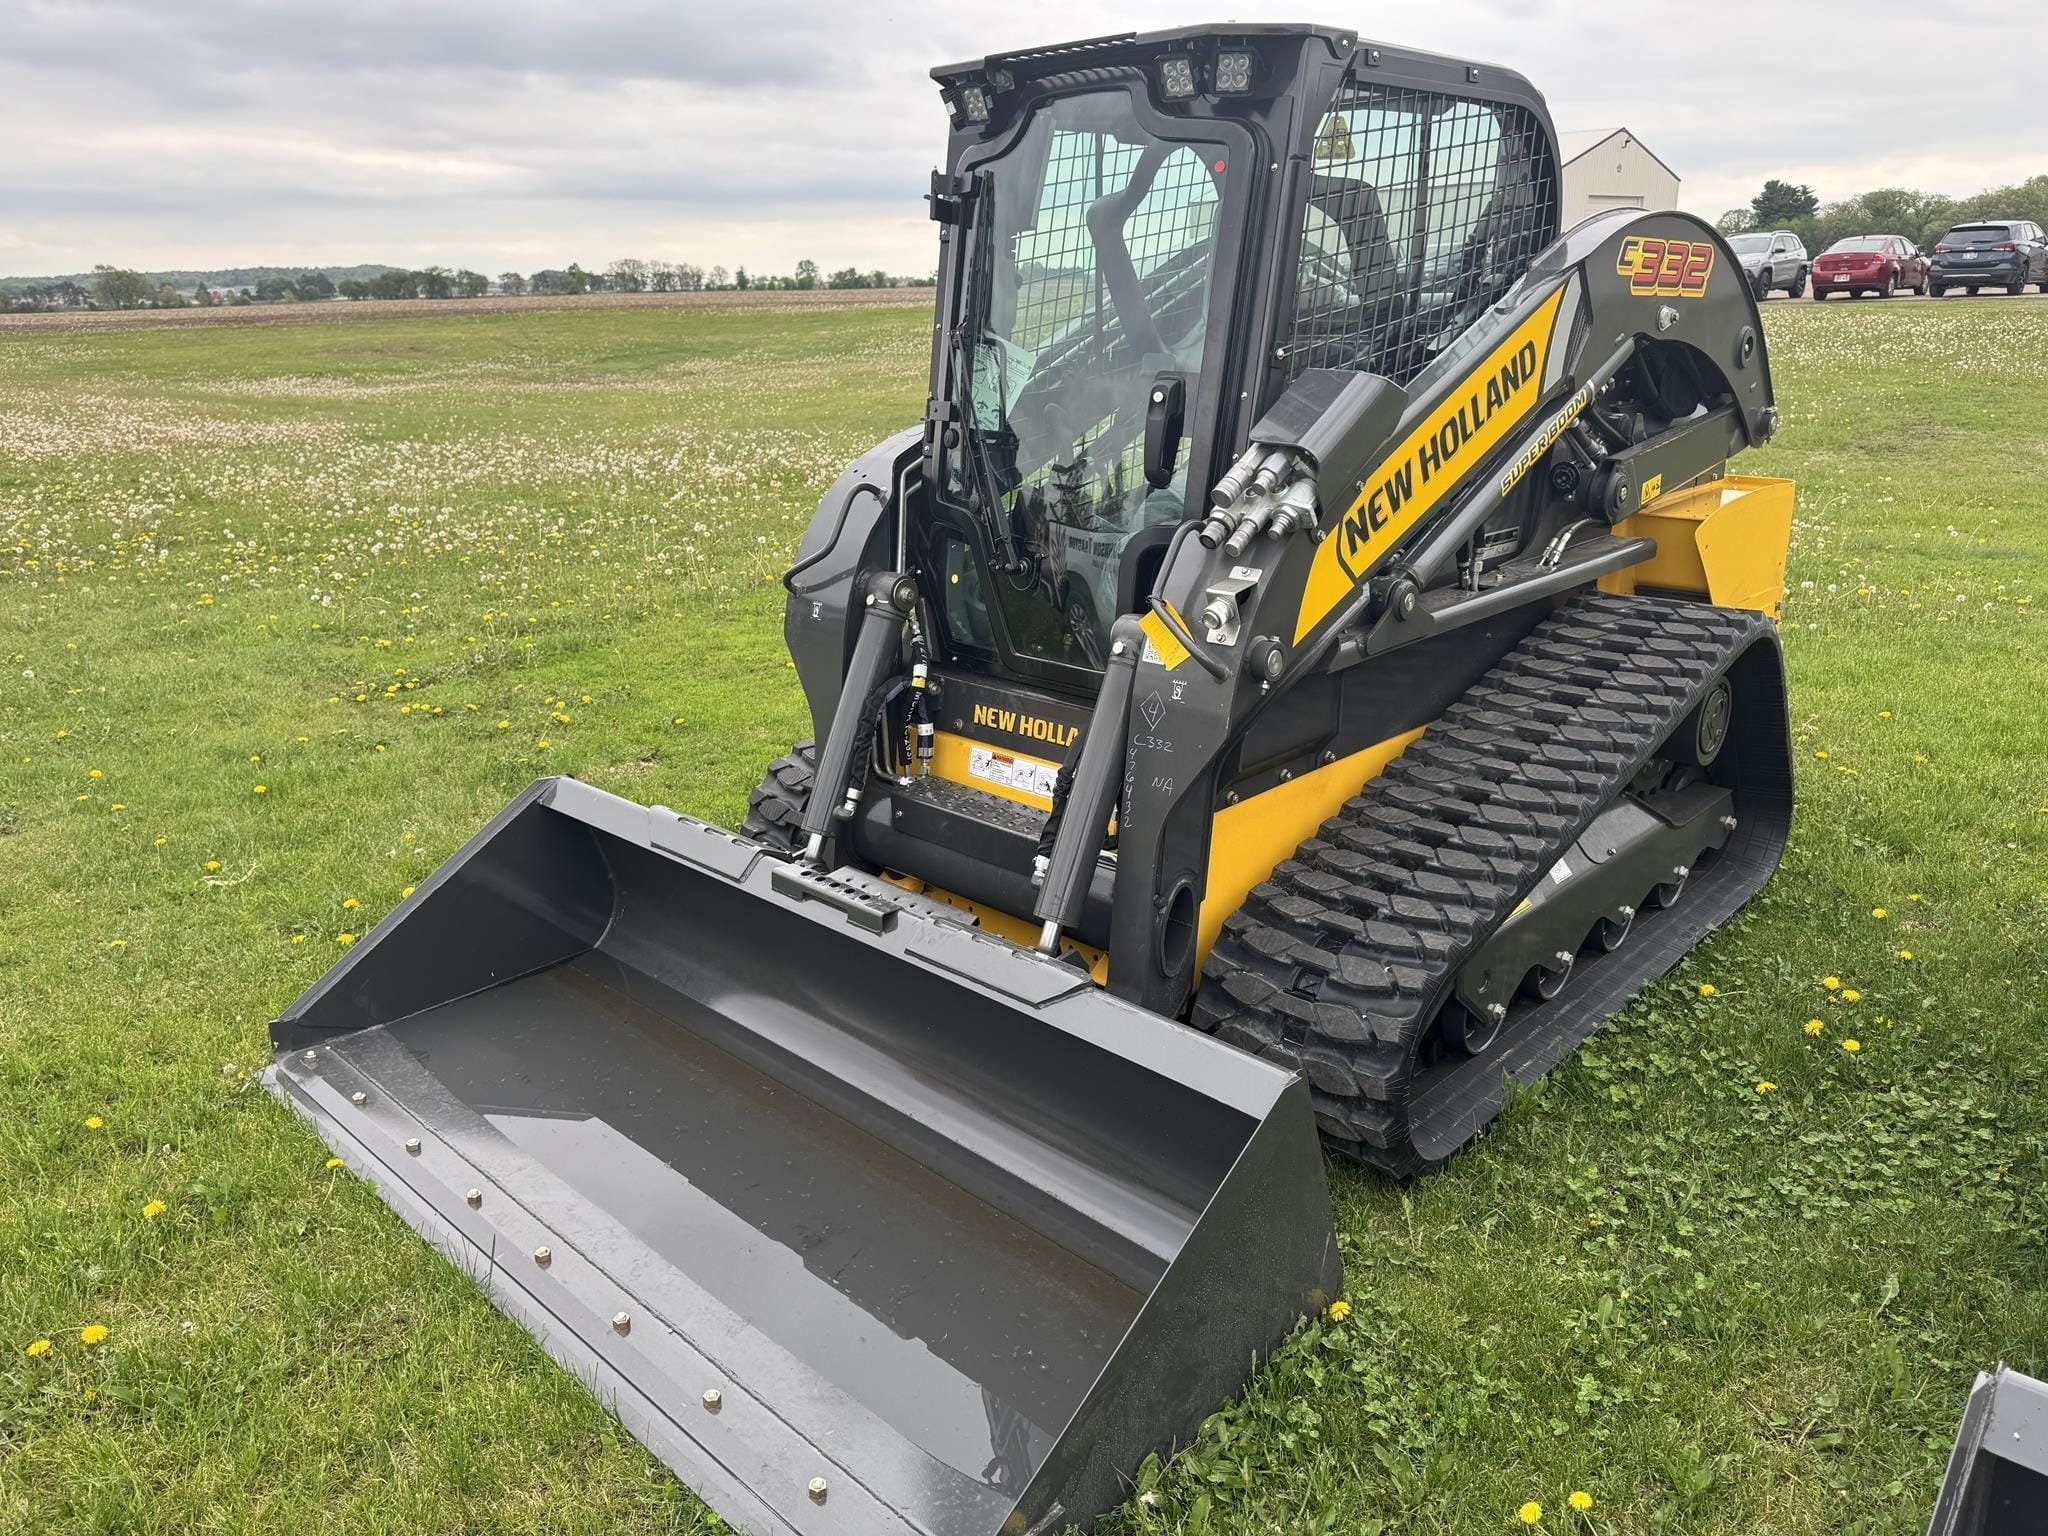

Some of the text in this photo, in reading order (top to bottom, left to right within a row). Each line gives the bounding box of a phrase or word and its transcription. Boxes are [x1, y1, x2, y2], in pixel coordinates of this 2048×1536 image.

[1617, 236, 1715, 298] C332
[1343, 340, 1536, 557] NEW HOLLAND
[1502, 437, 1550, 497] SUPER
[1549, 388, 1587, 441] BOOM
[973, 704, 1078, 746] NEW HOLLA
[1151, 777, 1174, 797] NA
